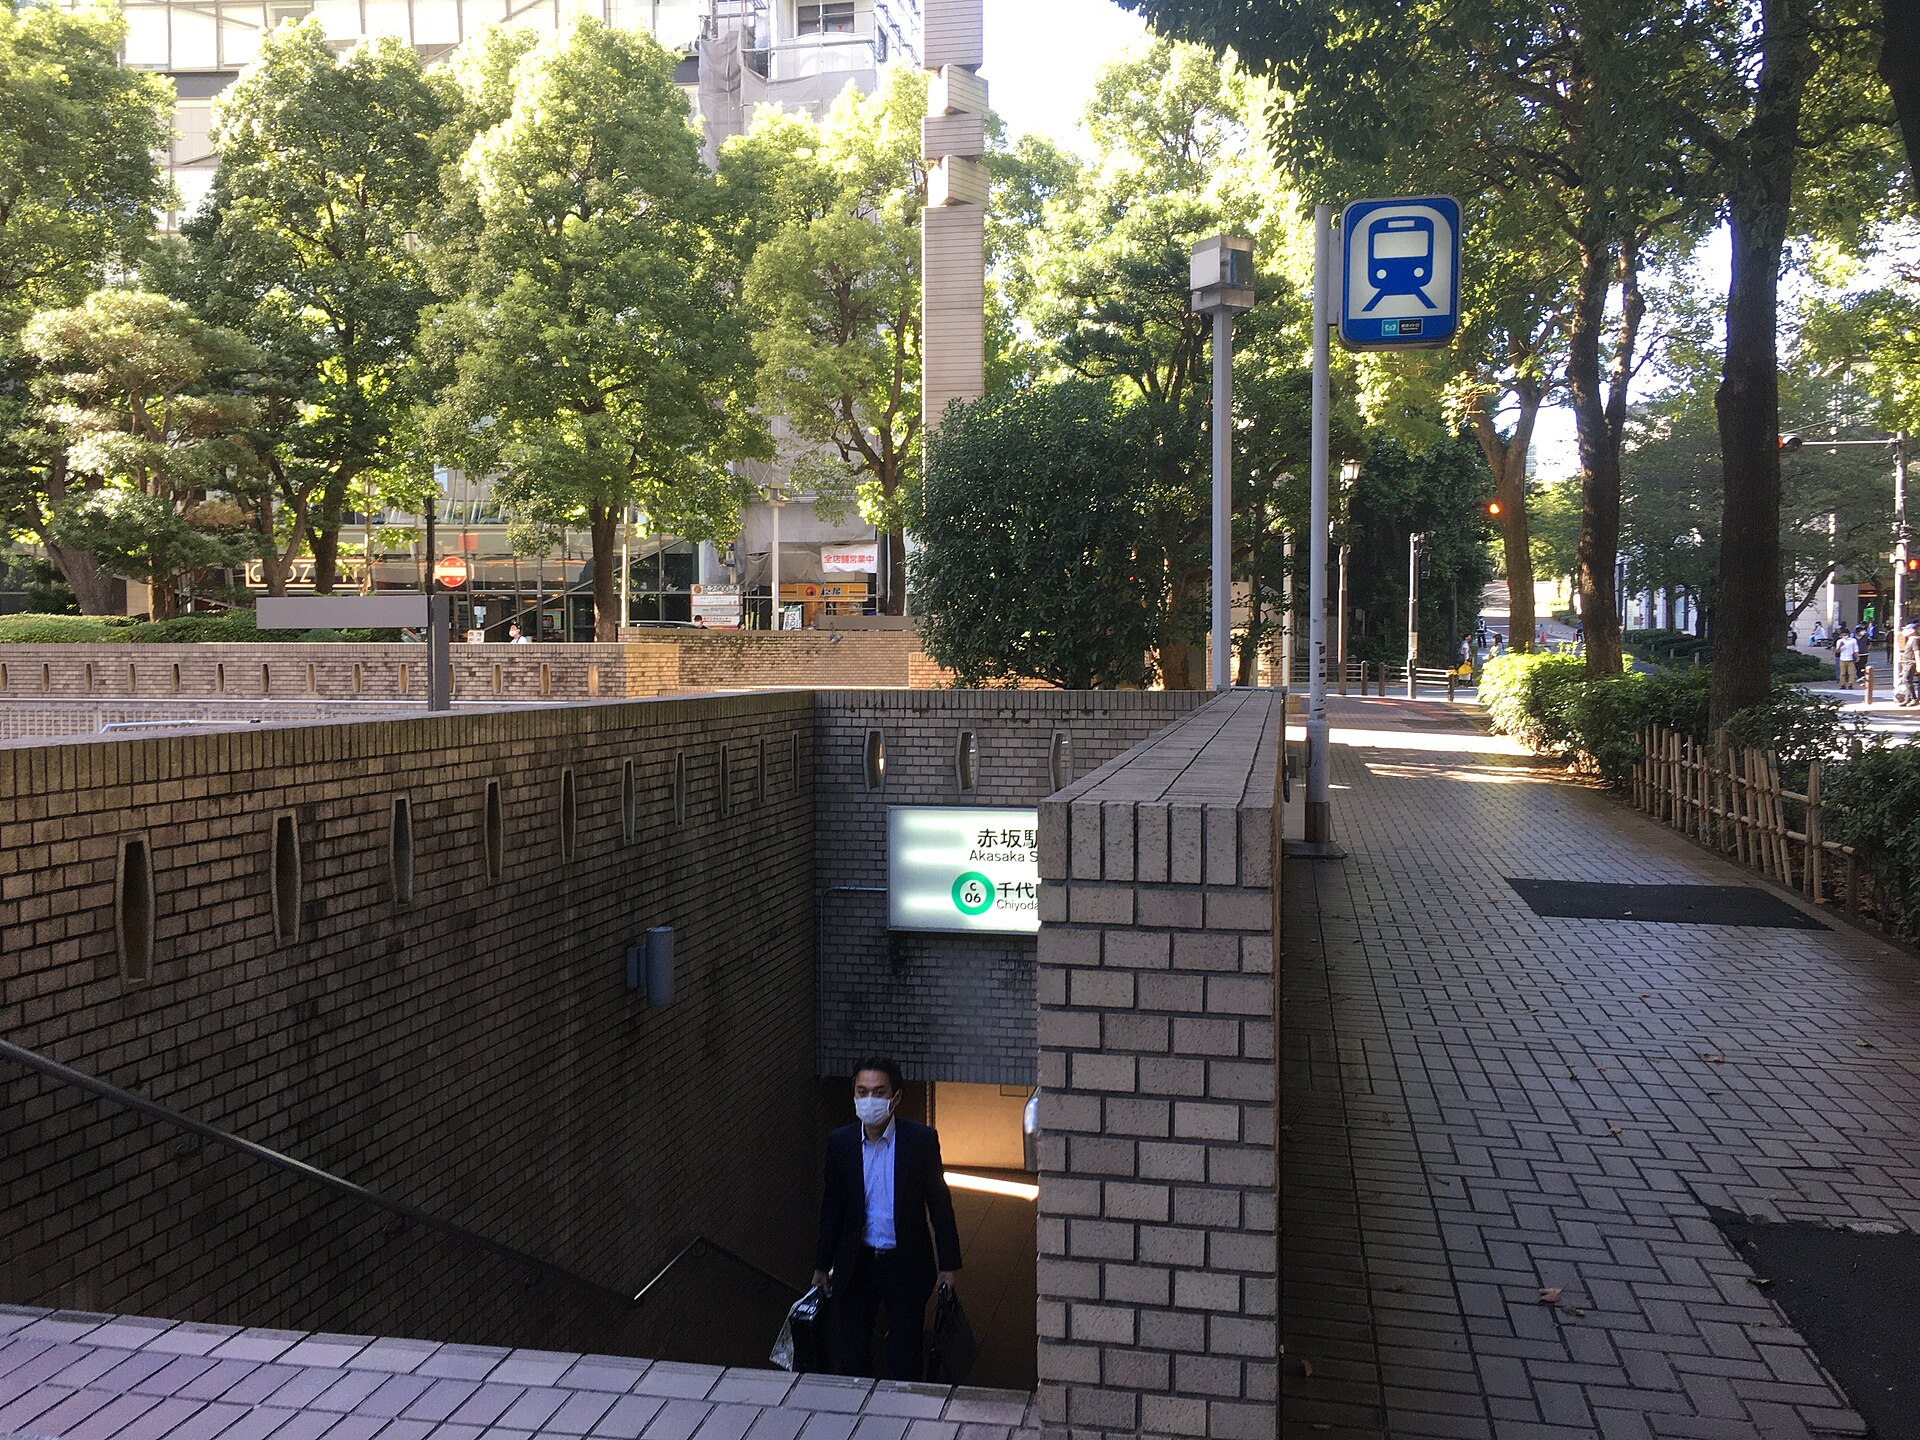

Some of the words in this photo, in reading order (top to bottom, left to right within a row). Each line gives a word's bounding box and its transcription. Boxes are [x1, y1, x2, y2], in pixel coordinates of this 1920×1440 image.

[823, 554, 875, 564] 全店舗営業中
[977, 828, 1038, 849] 赤坂駅
[969, 850, 1025, 862] Akasaka
[1029, 851, 1038, 862] S
[970, 882, 977, 891] C
[996, 882, 1038, 899] 千代
[965, 893, 981, 903] 06
